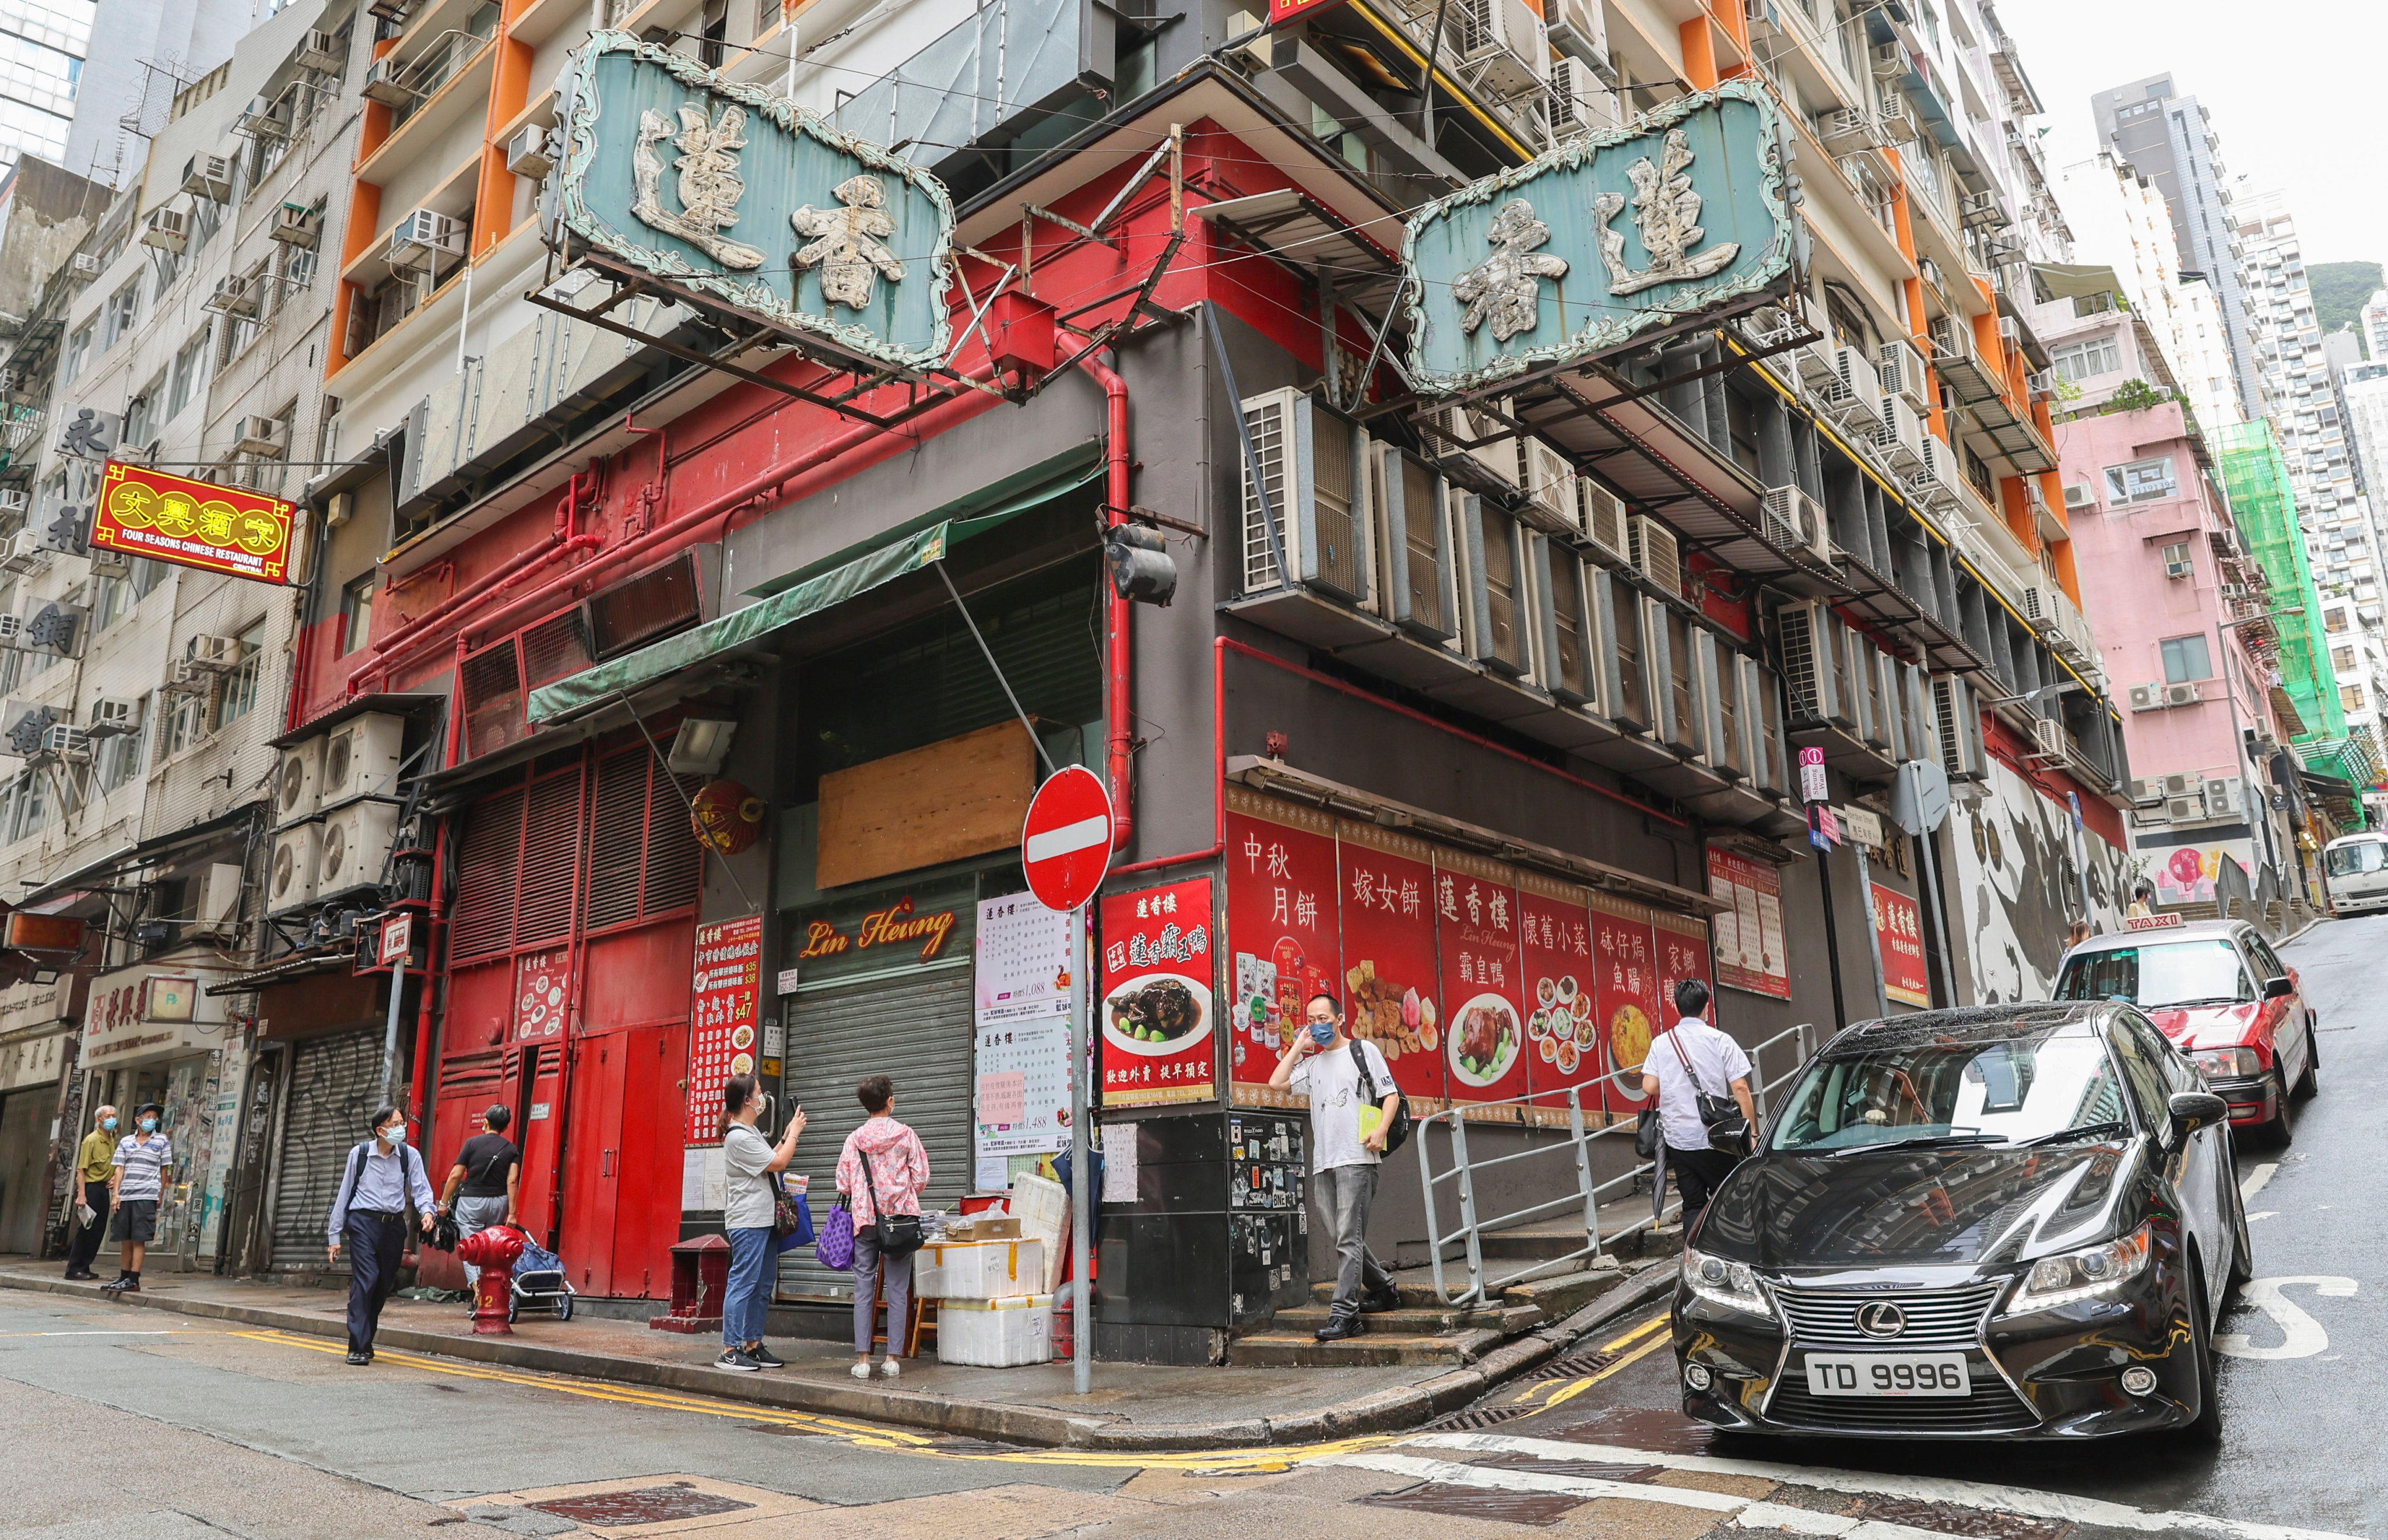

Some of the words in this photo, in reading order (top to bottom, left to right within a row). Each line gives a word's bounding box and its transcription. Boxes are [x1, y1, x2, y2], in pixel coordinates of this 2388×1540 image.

[2131, 480, 2176, 495] 31191399
[114, 491, 276, 547] 文興酒家
[122, 529, 143, 542] FOUR
[145, 535, 181, 550] SEASONS
[182, 542, 215, 558] CHINESE
[216, 549, 264, 567] RESTAURANT
[1863, 814, 1873, 825] Street
[1244, 832, 1292, 880] 中秋
[1136, 892, 1178, 919] 蓮香樓
[1352, 867, 1421, 920] 嫁女餅
[1440, 875, 1510, 933] 蓮香樓
[986, 904, 1015, 920] 蓮香樓
[1272, 887, 1318, 932] 月餅
[1887, 901, 1918, 940] 蓮香樓
[1460, 923, 1479, 943] Lin
[2128, 915, 2178, 929] TAXI
[699, 926, 722, 945] 蓮香樓
[799, 921, 849, 959] Lin
[858, 906, 955, 963] Heung
[1129, 922, 1207, 967] 蓮香霸王鴨
[1523, 912, 1588, 958] 懷舊小菜
[1600, 926, 1645, 964] 砵仔焗
[525, 954, 547, 971] 蓮香樓
[746, 961, 756, 972] $35
[1459, 952, 1504, 988] 霸皇鴨
[1668, 943, 1695, 977] 家鄉
[745, 973, 756, 985] $38
[779, 982, 796, 993] 162-164
[1613, 962, 1641, 996] 魚腸
[739, 991, 751, 1002] 一律
[735, 1002, 752, 1020] $47
[985, 1032, 1013, 1047] 蓮香樓
[1107, 1064, 1151, 1085] 歡迎外賣
[1160, 1061, 1209, 1080] 提早預定
[981, 1080, 1023, 1091] 由於疫情關係本店
[1274, 1193, 1286, 1206] BNE
[1256, 1216, 1265, 1226] sick
[1814, 1364, 1857, 1389] TD
[1871, 1363, 1961, 1390] 9996
